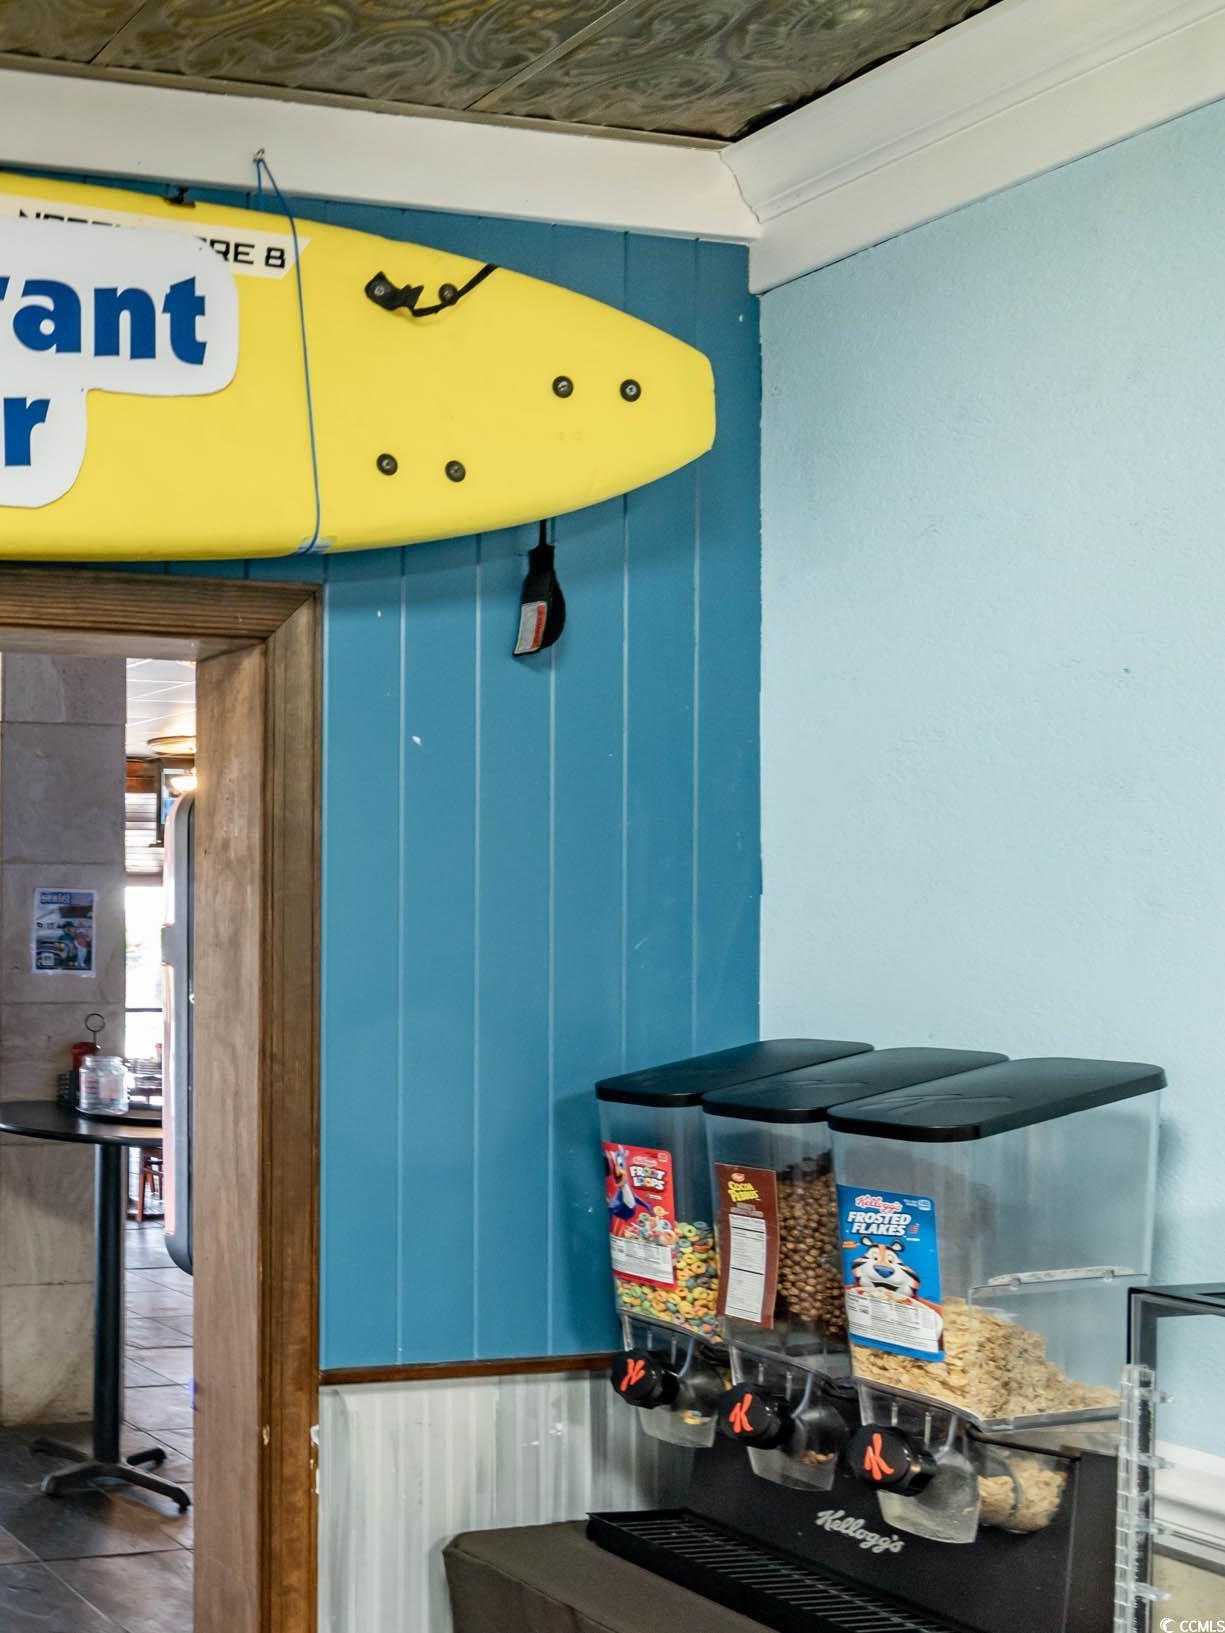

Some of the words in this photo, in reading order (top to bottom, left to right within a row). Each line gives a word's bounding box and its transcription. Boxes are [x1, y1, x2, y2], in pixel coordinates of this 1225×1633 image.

[847, 1211, 912, 1225] FROSTED
[851, 1222, 907, 1237] FLAKES
[815, 1509, 905, 1554] Kellogg's
